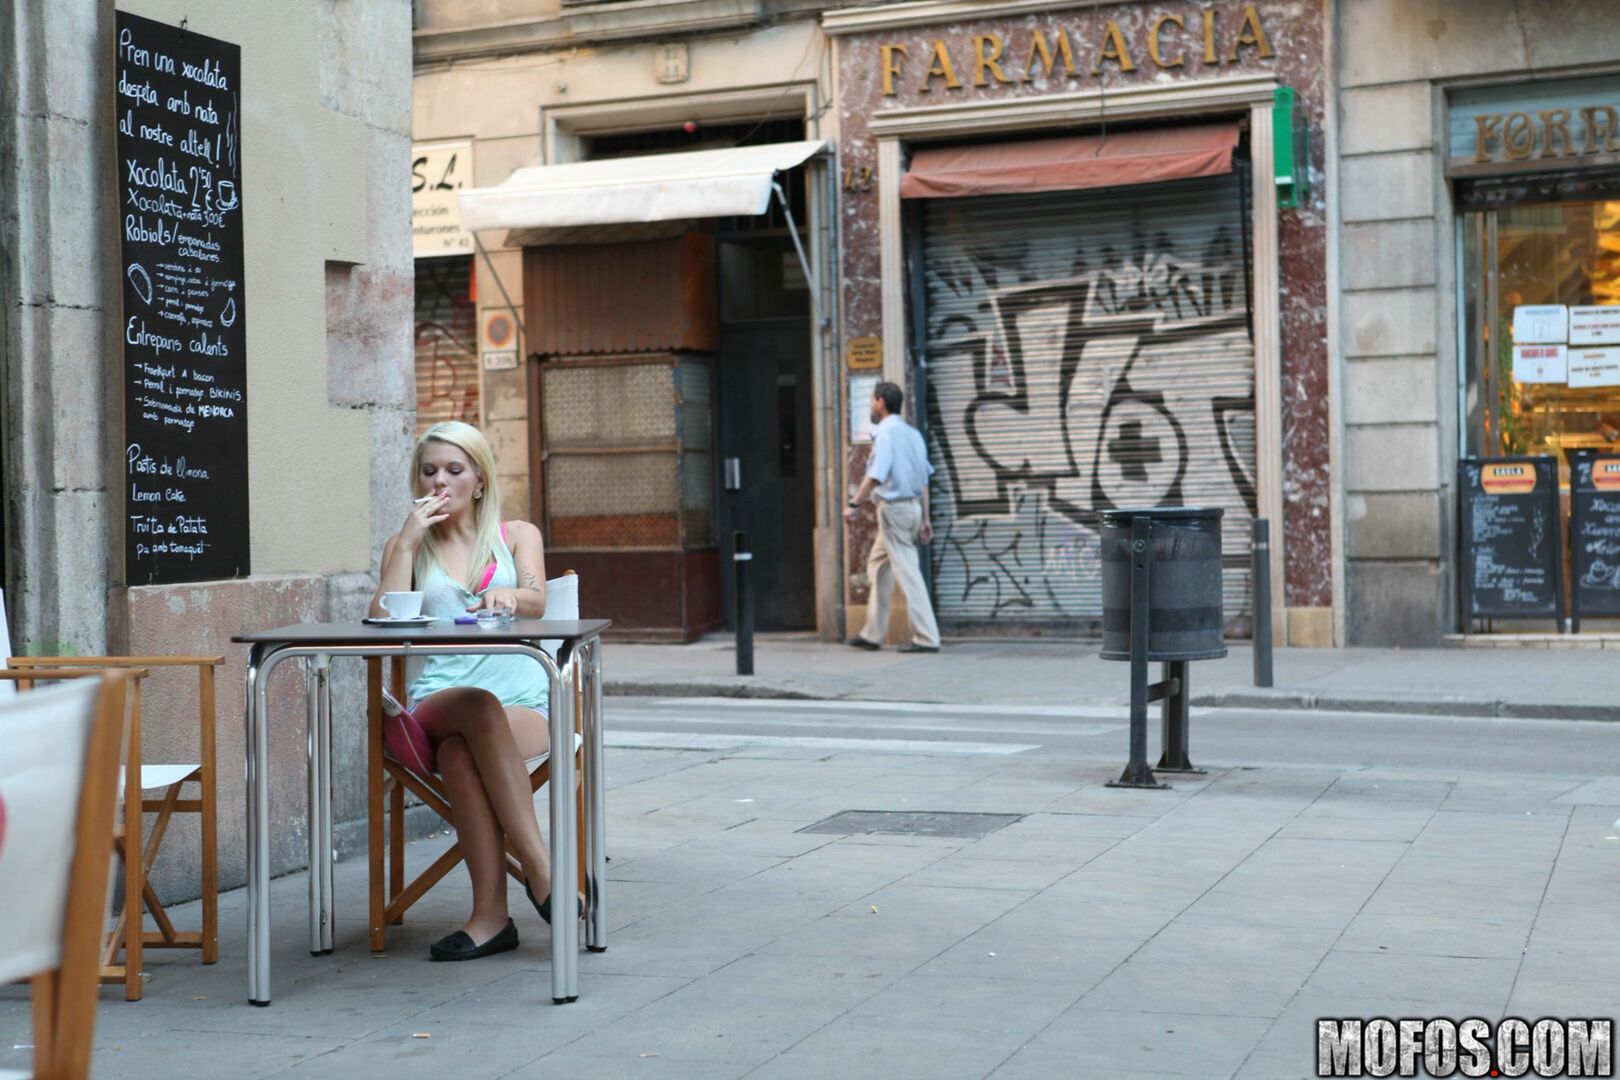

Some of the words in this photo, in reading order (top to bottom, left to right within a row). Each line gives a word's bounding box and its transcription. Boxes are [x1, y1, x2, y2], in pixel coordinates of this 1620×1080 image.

[119, 28, 149, 67] Pren
[154, 52, 176, 76] una
[182, 58, 228, 91] xocolata
[880, 5, 1277, 96] FARMACIA
[167, 90, 191, 115] amb
[195, 99, 219, 125] nata
[119, 109, 134, 138] al
[140, 124, 174, 147] nostre
[126, 157, 188, 195] Xocolata
[127, 316, 182, 355] Entrepans
[189, 332, 228, 356] calents
[193, 370, 215, 383] bacon
[186, 403, 195, 414] de
[198, 405, 234, 418] MENORCA
[160, 456, 172, 475] de
[132, 483, 161, 501] Lemon
[165, 488, 186, 502] Cake
[130, 515, 164, 534] Truita
[168, 523, 177, 534] de
[152, 541, 168, 553] amb
